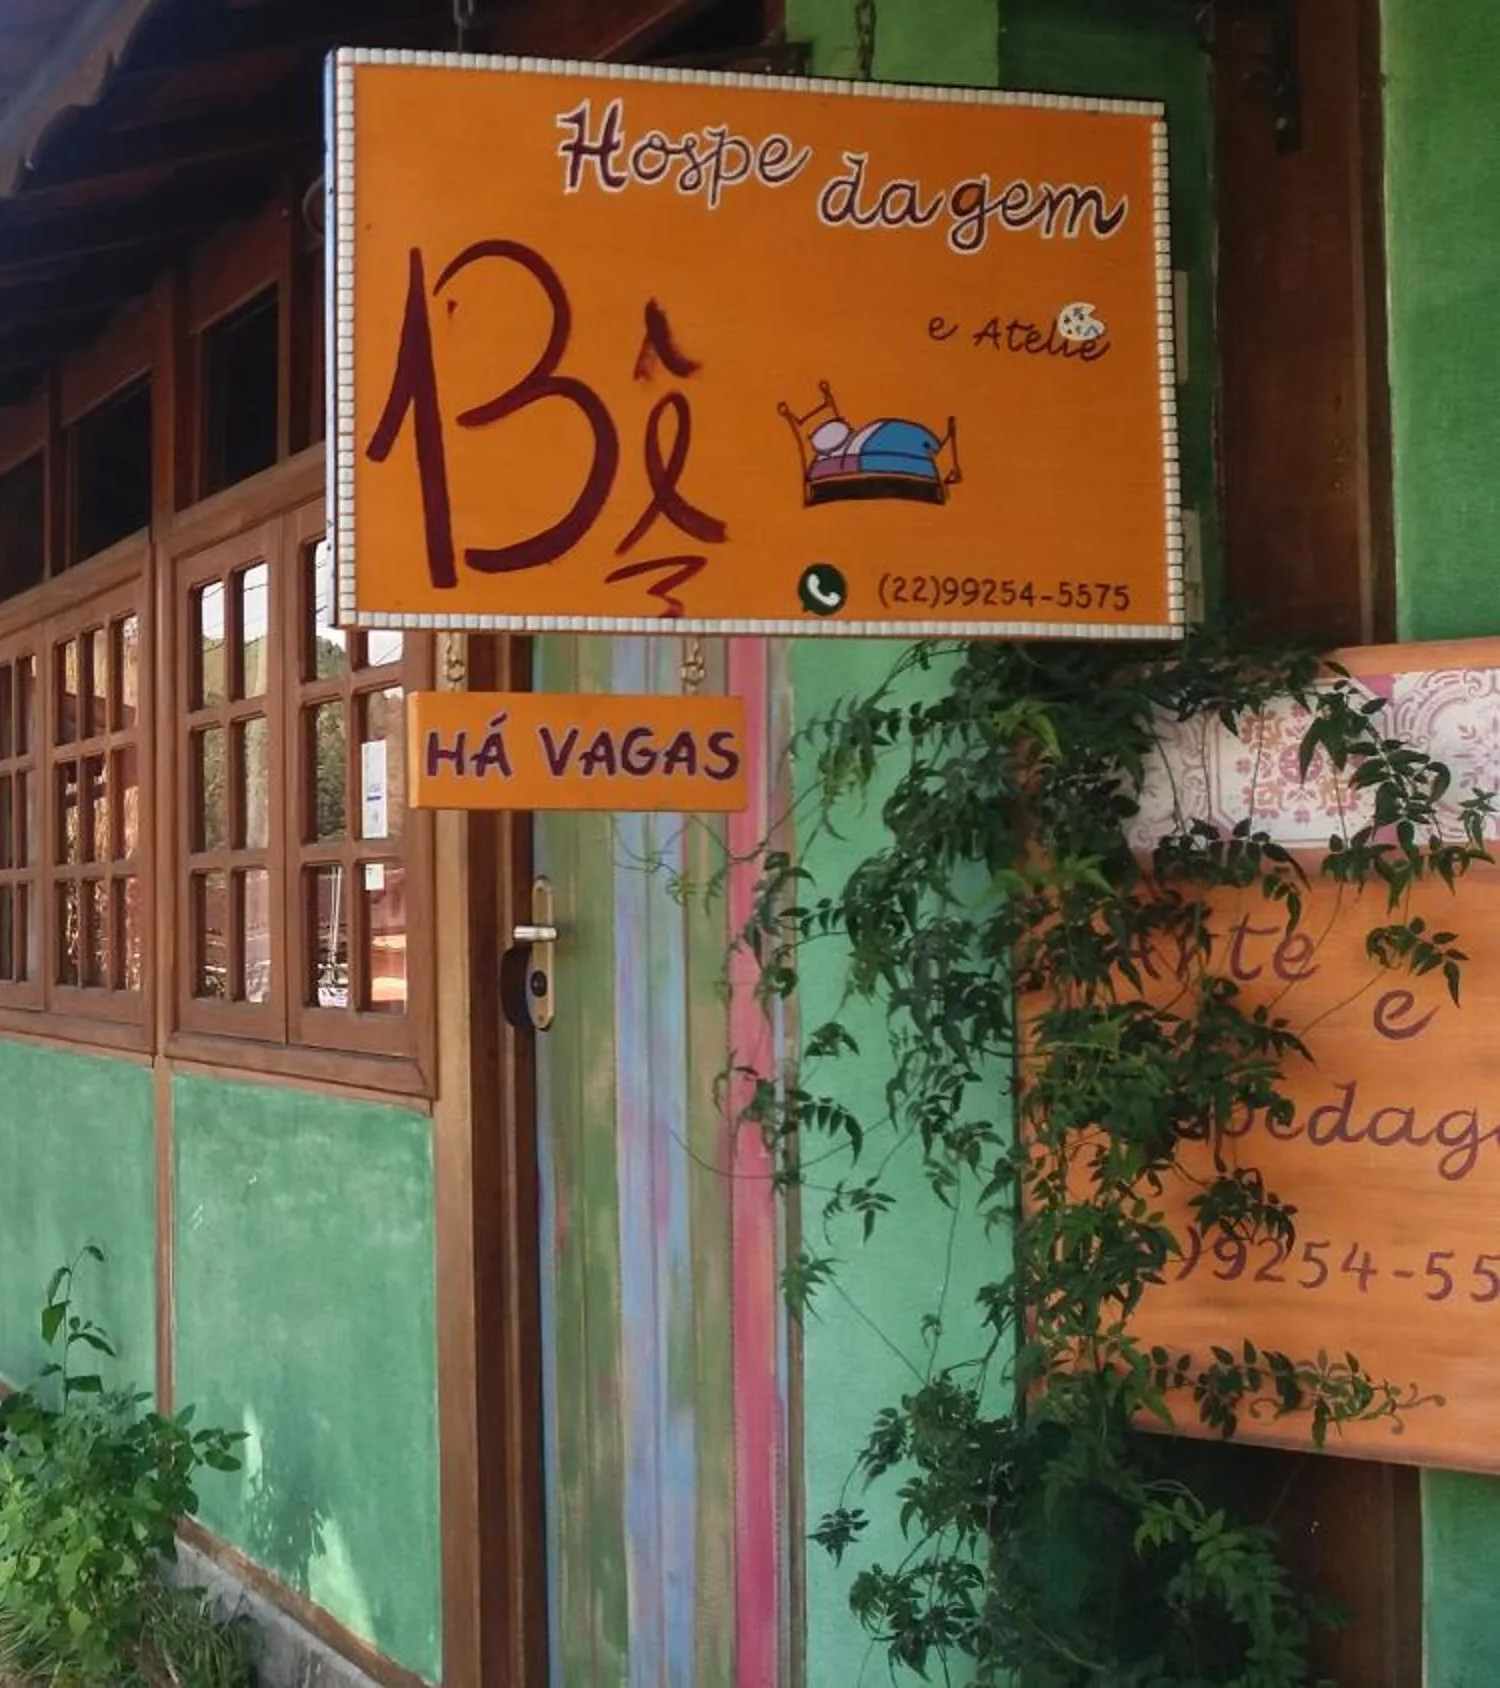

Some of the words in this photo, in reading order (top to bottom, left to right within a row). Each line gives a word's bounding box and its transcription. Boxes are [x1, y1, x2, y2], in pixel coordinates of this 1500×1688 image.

[928, 315, 959, 341] e
[877, 572, 1131, 612] (22)99254-5575
[426, 712, 513, 777] HÁ
[538, 726, 741, 781] VAGAS
[1373, 989, 1440, 1041] e
